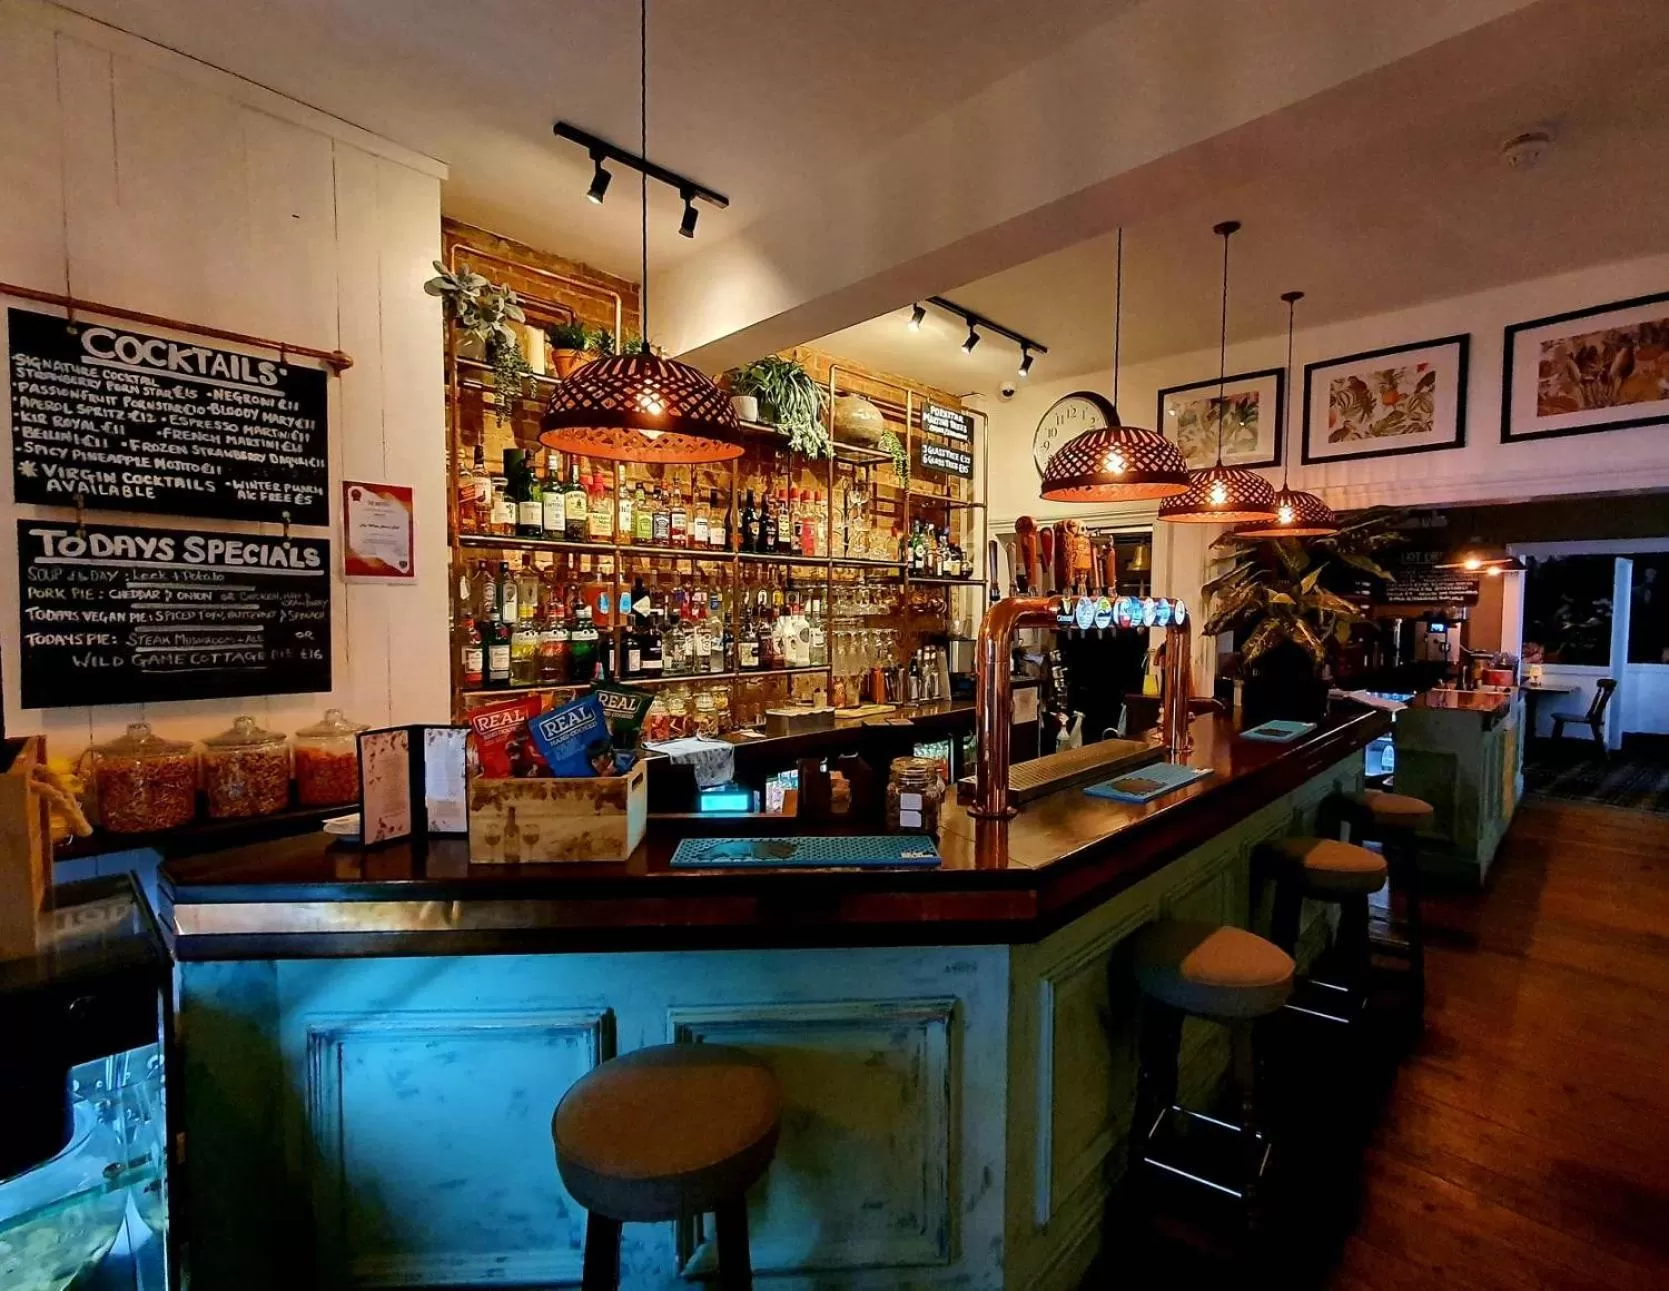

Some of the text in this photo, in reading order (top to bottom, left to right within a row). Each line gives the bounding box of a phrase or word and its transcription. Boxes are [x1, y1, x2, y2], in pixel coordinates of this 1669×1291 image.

[81, 328, 278, 385] COCKTAILS
[15, 354, 160, 387] SIGNATURE COCKTAIL
[143, 386, 172, 399] STAR
[213, 389, 274, 408] NEGRONI
[20, 396, 72, 414] APEROL
[77, 403, 125, 420] SPRITZ
[210, 403, 259, 421] BLOODY
[262, 412, 294, 428] MARY
[1066, 407, 1077, 419] 12
[21, 411, 48, 424] KIR
[52, 416, 99, 432] ROYAL
[170, 415, 238, 432] ESPRESSO
[1056, 414, 1064, 426] 11
[1089, 416, 1096, 428] 2
[163, 427, 221, 444] FRENCH
[225, 436, 279, 450] MARTINI
[1047, 427, 1058, 438] 10
[129, 439, 188, 454] FROZEN
[1043, 440, 1050, 452] 9
[24, 442, 68, 459] SPICY
[72, 449, 152, 468] PINEAPPLE
[41, 464, 216, 492] VIRGIN COCKTAILS
[232, 480, 281, 492] WINTER
[47, 479, 156, 499] AVAILABLE
[260, 492, 292, 502] FREE
[28, 528, 321, 568] TODAYS SPECIALS
[28, 587, 66, 599] PORK
[109, 589, 160, 600] CHEDDAR
[177, 592, 212, 601] ONION
[81, 611, 127, 624] VEGAN
[125, 633, 171, 647] STEAK
[72, 652, 124, 668] WILD
[131, 652, 184, 667] GAME
[190, 651, 265, 665] COTTAGE
[599, 693, 636, 711] REAL
[477, 709, 525, 732] REAL
[543, 706, 591, 738] REAL
